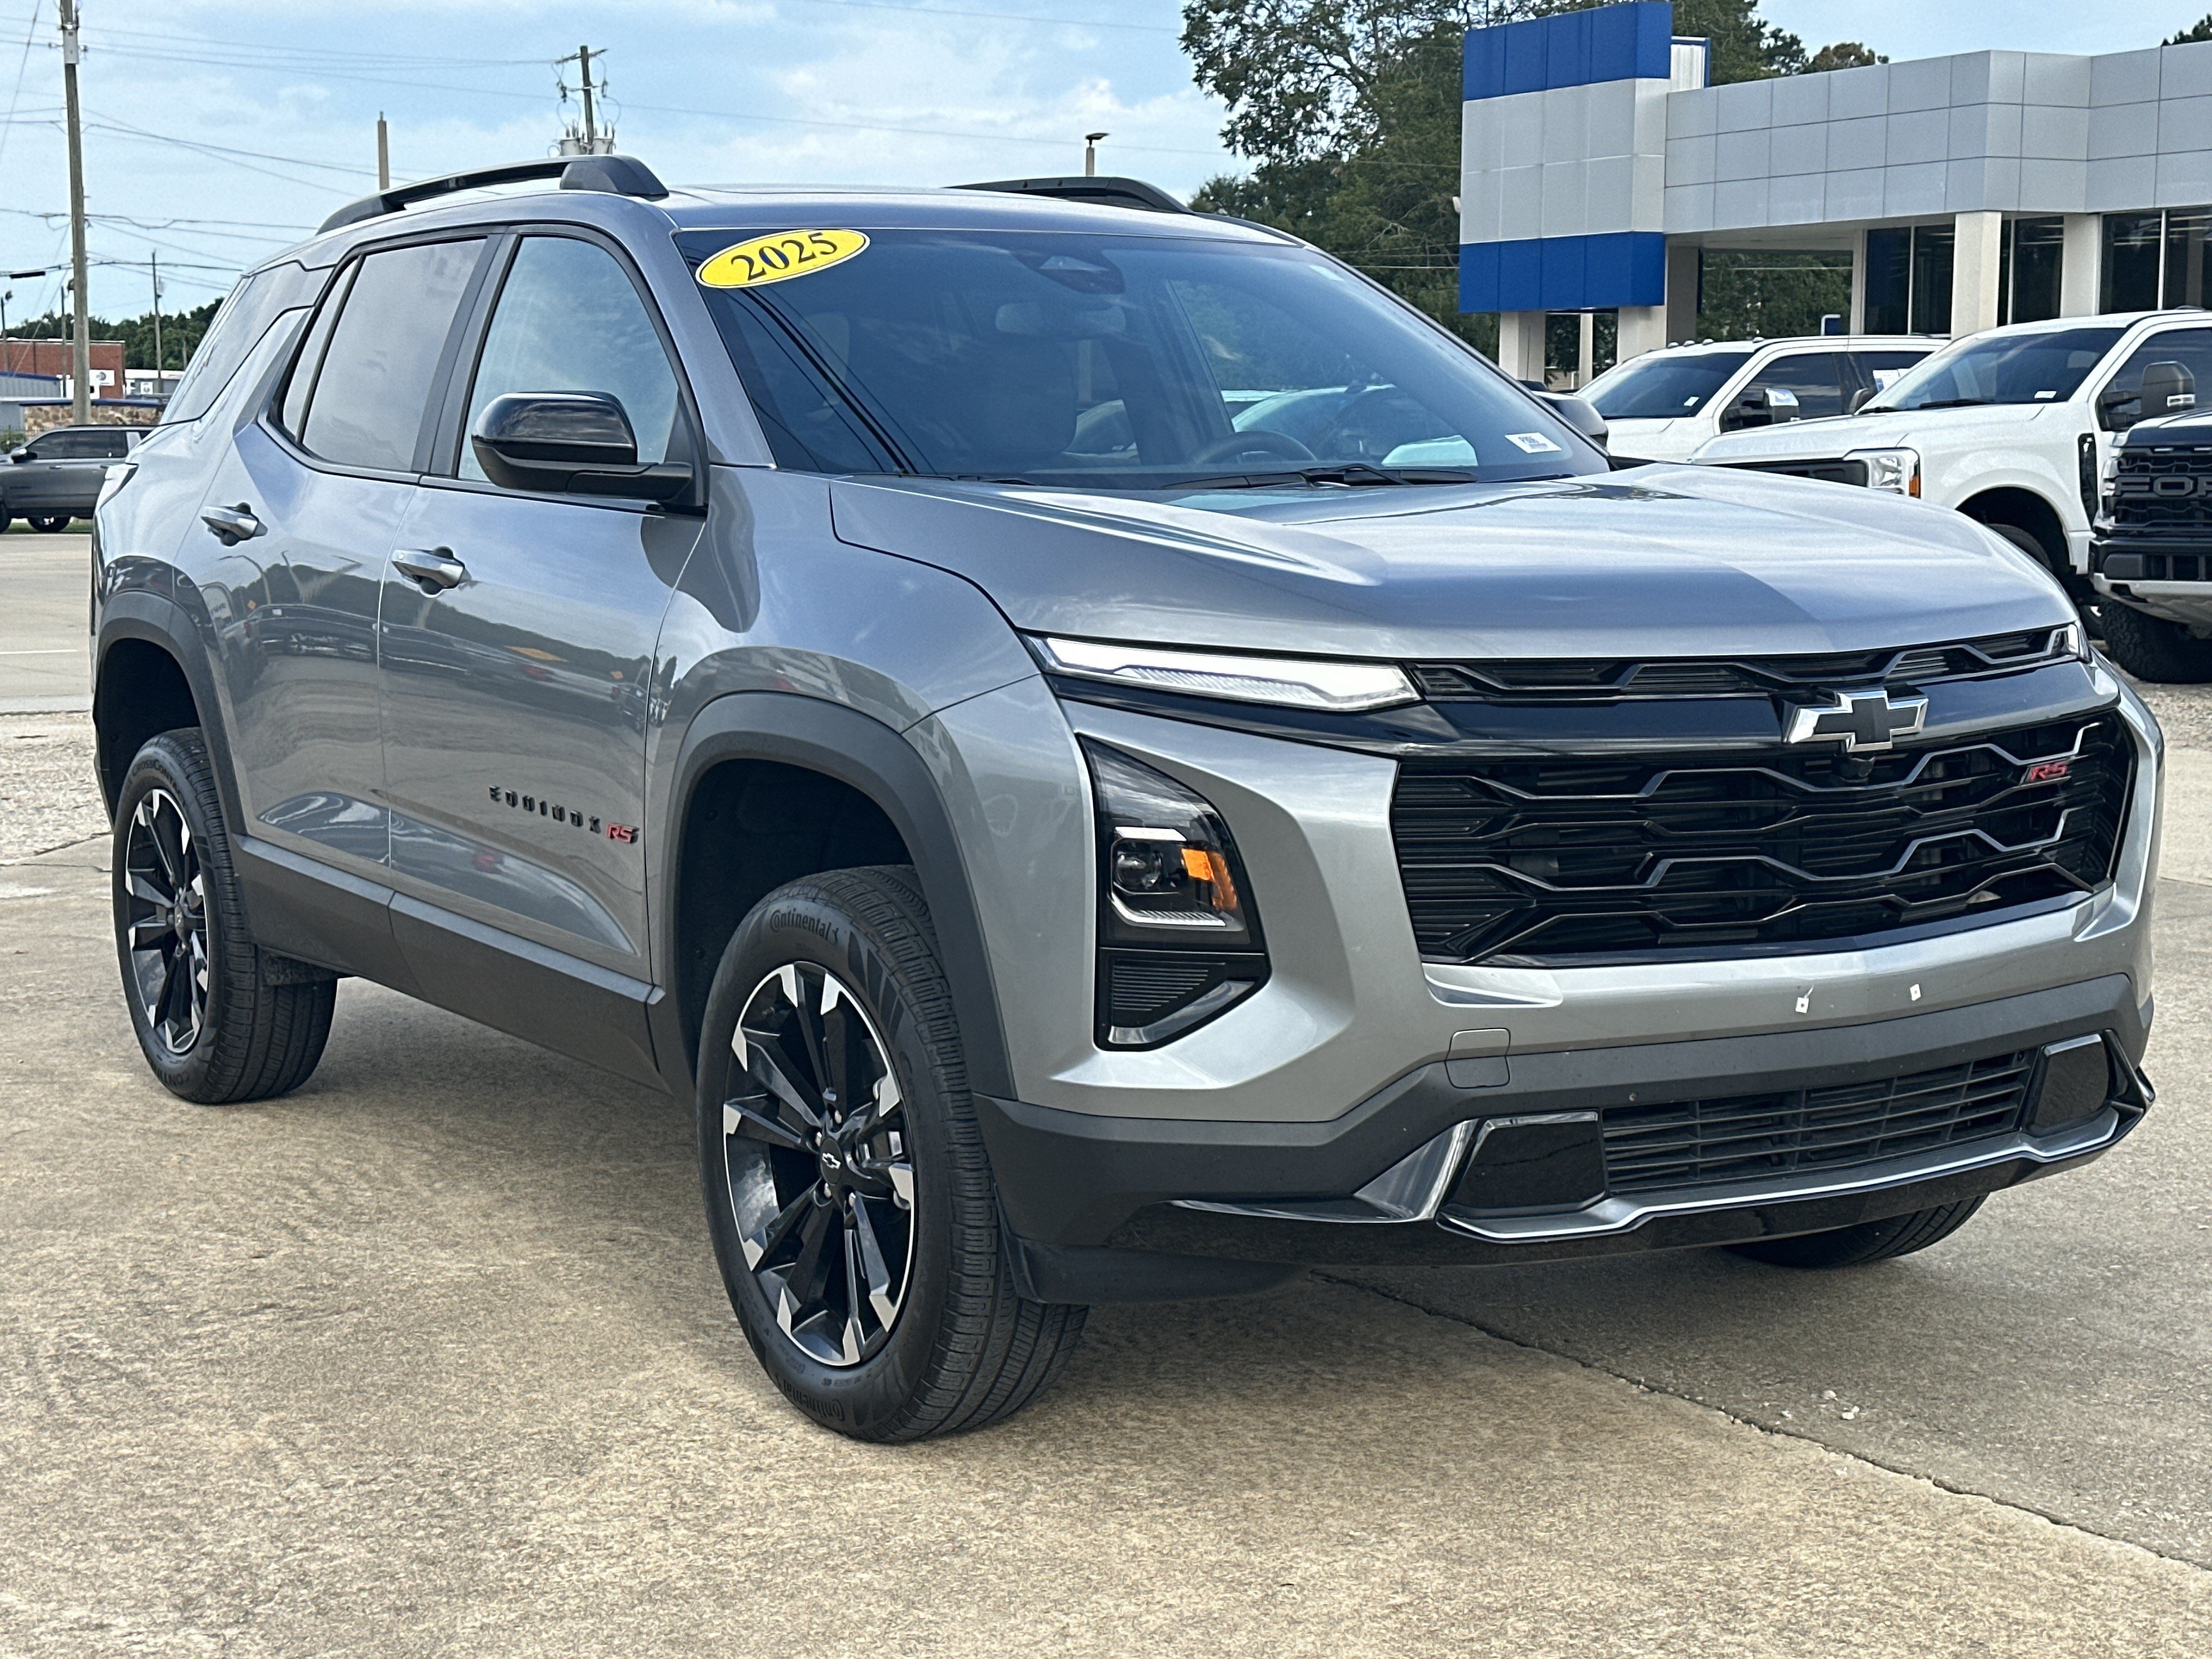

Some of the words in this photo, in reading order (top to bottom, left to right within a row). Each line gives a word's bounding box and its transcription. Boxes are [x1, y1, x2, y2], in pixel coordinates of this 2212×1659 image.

[731, 232, 838, 281] 2025
[2030, 761, 2068, 782] RS
[489, 785, 602, 834] EQUINOX
[605, 823, 640, 844] RS
[770, 907, 832, 941] Continental
